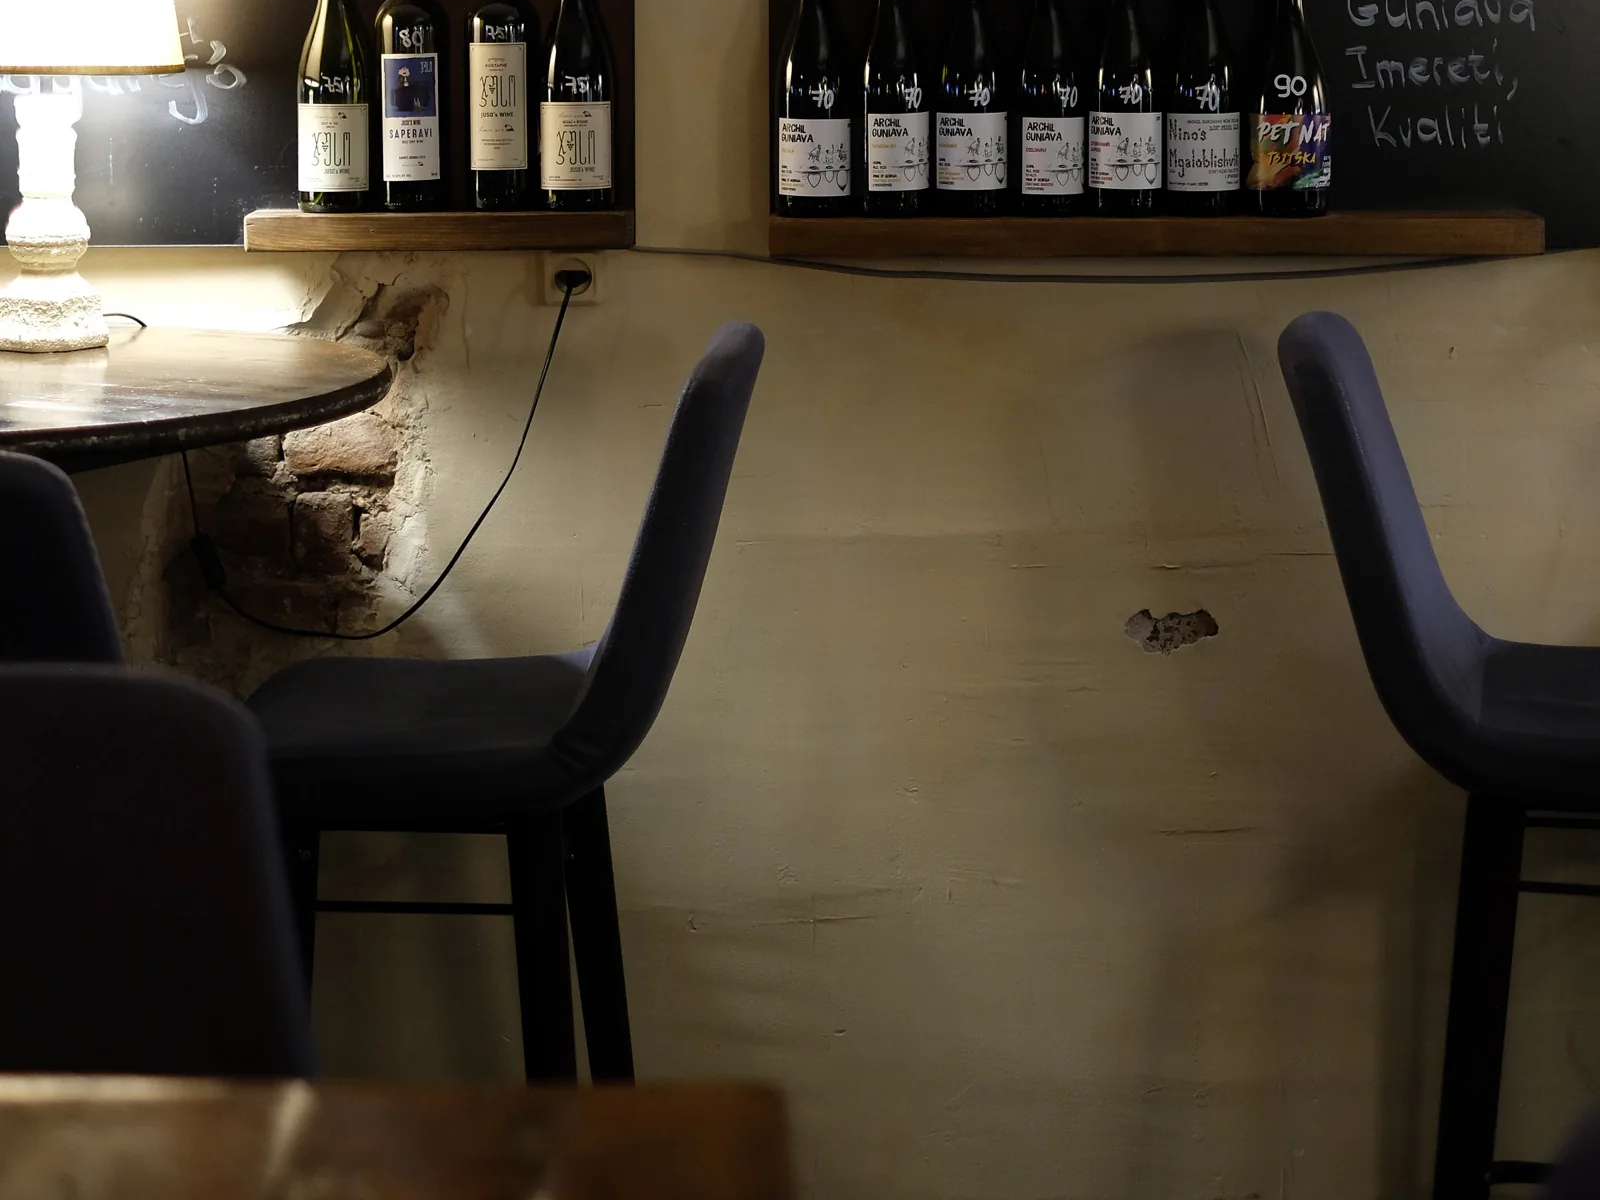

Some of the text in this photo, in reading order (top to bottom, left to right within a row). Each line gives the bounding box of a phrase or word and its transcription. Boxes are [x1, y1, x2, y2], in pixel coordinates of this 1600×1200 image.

[399, 29, 423, 48] 80
[1345, 37, 1519, 100] Imereti,
[1274, 74, 1307, 98] 90
[873, 118, 901, 127] ARCHIL
[940, 117, 965, 127] ARCHIL
[1091, 116, 1114, 126] ARCHIL
[782, 123, 806, 133] ARCHIL
[939, 127, 972, 136] GUNIAVA
[1027, 122, 1055, 131] ARCHIL
[1091, 126, 1121, 136] GUNIAVA
[1170, 119, 1206, 141] Nino's
[1367, 103, 1504, 150] Kvaliti
[389, 129, 432, 139] SAPERAVI
[782, 133, 813, 142] GUNIAVA
[872, 128, 908, 137] GUNIAVA
[1026, 132, 1062, 141] GUNIAVA
[1257, 120, 1330, 146] PET NAT
